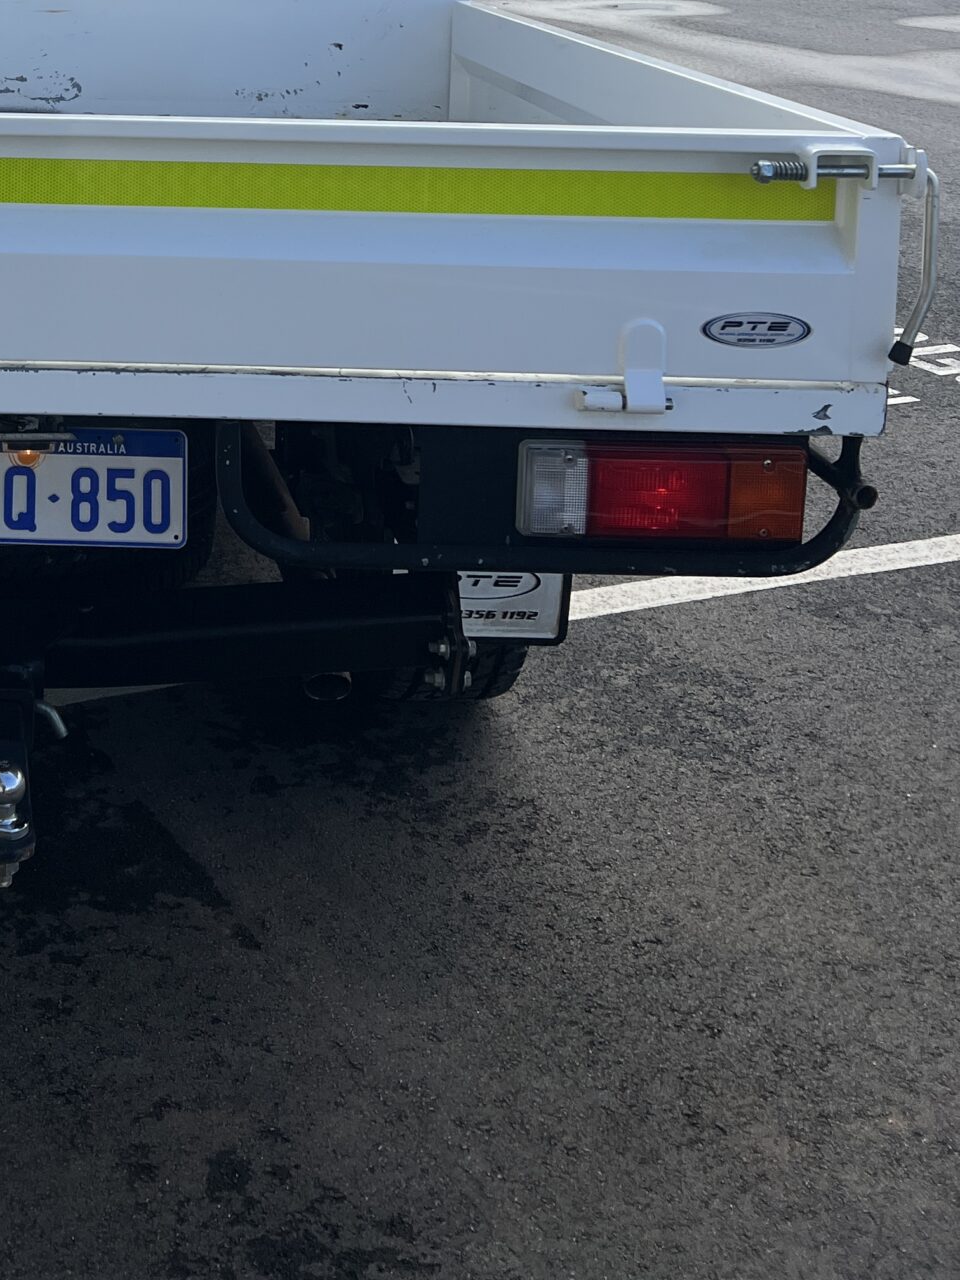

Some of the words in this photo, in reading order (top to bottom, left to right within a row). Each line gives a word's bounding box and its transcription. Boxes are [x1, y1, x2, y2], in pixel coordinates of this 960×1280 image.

[720, 320, 792, 332] PTE
[57, 442, 127, 454] AUSTRALIA
[458, 573, 523, 588] TE
[460, 609, 497, 620] 356
[501, 610, 539, 621] 1192
